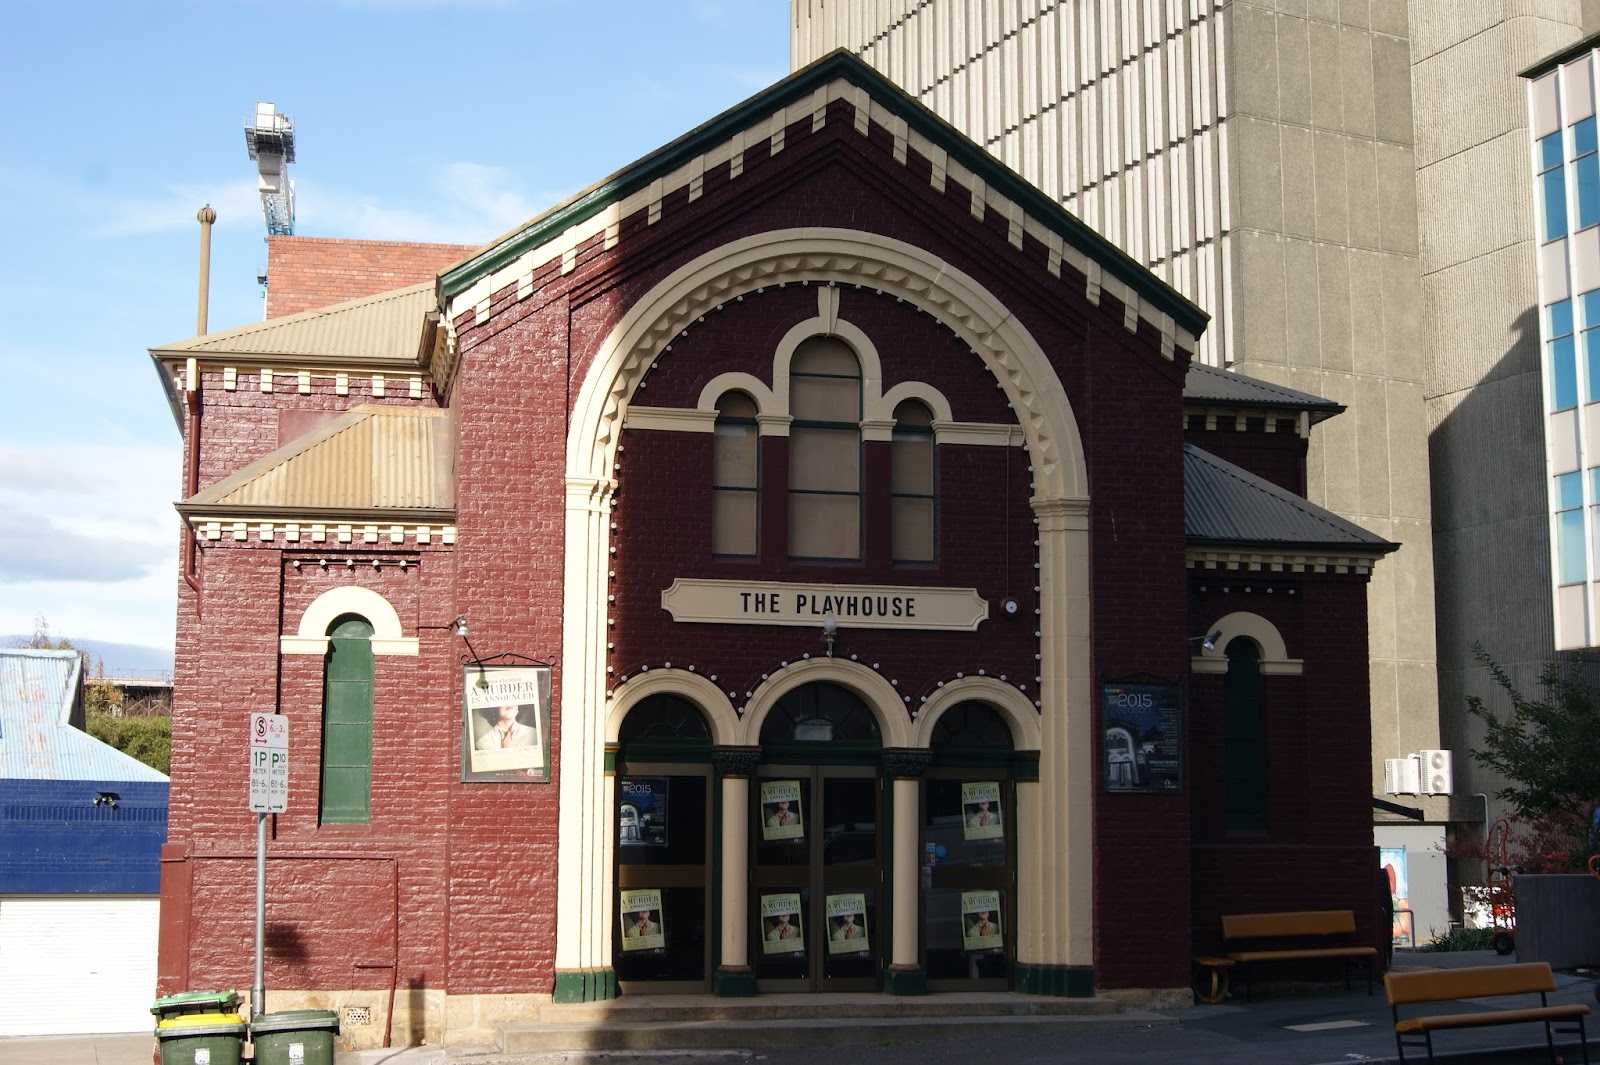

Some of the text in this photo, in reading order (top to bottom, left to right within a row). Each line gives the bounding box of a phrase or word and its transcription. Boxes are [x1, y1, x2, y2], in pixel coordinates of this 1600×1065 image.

[740, 592, 916, 618] THE PLAYHOUSE
[471, 686, 478, 696] A
[484, 692, 534, 703] ANNOUNCED
[1117, 693, 1152, 707] 2015
[254, 751, 267, 767] 1P
[629, 784, 652, 793] 2015
[768, 787, 798, 795] MURDER
[968, 788, 998, 796] MURDER
[628, 895, 659, 904] MURDER
[768, 900, 798, 908] MURDER
[833, 900, 863, 908] MURDER
[968, 897, 997, 905] MURDER
